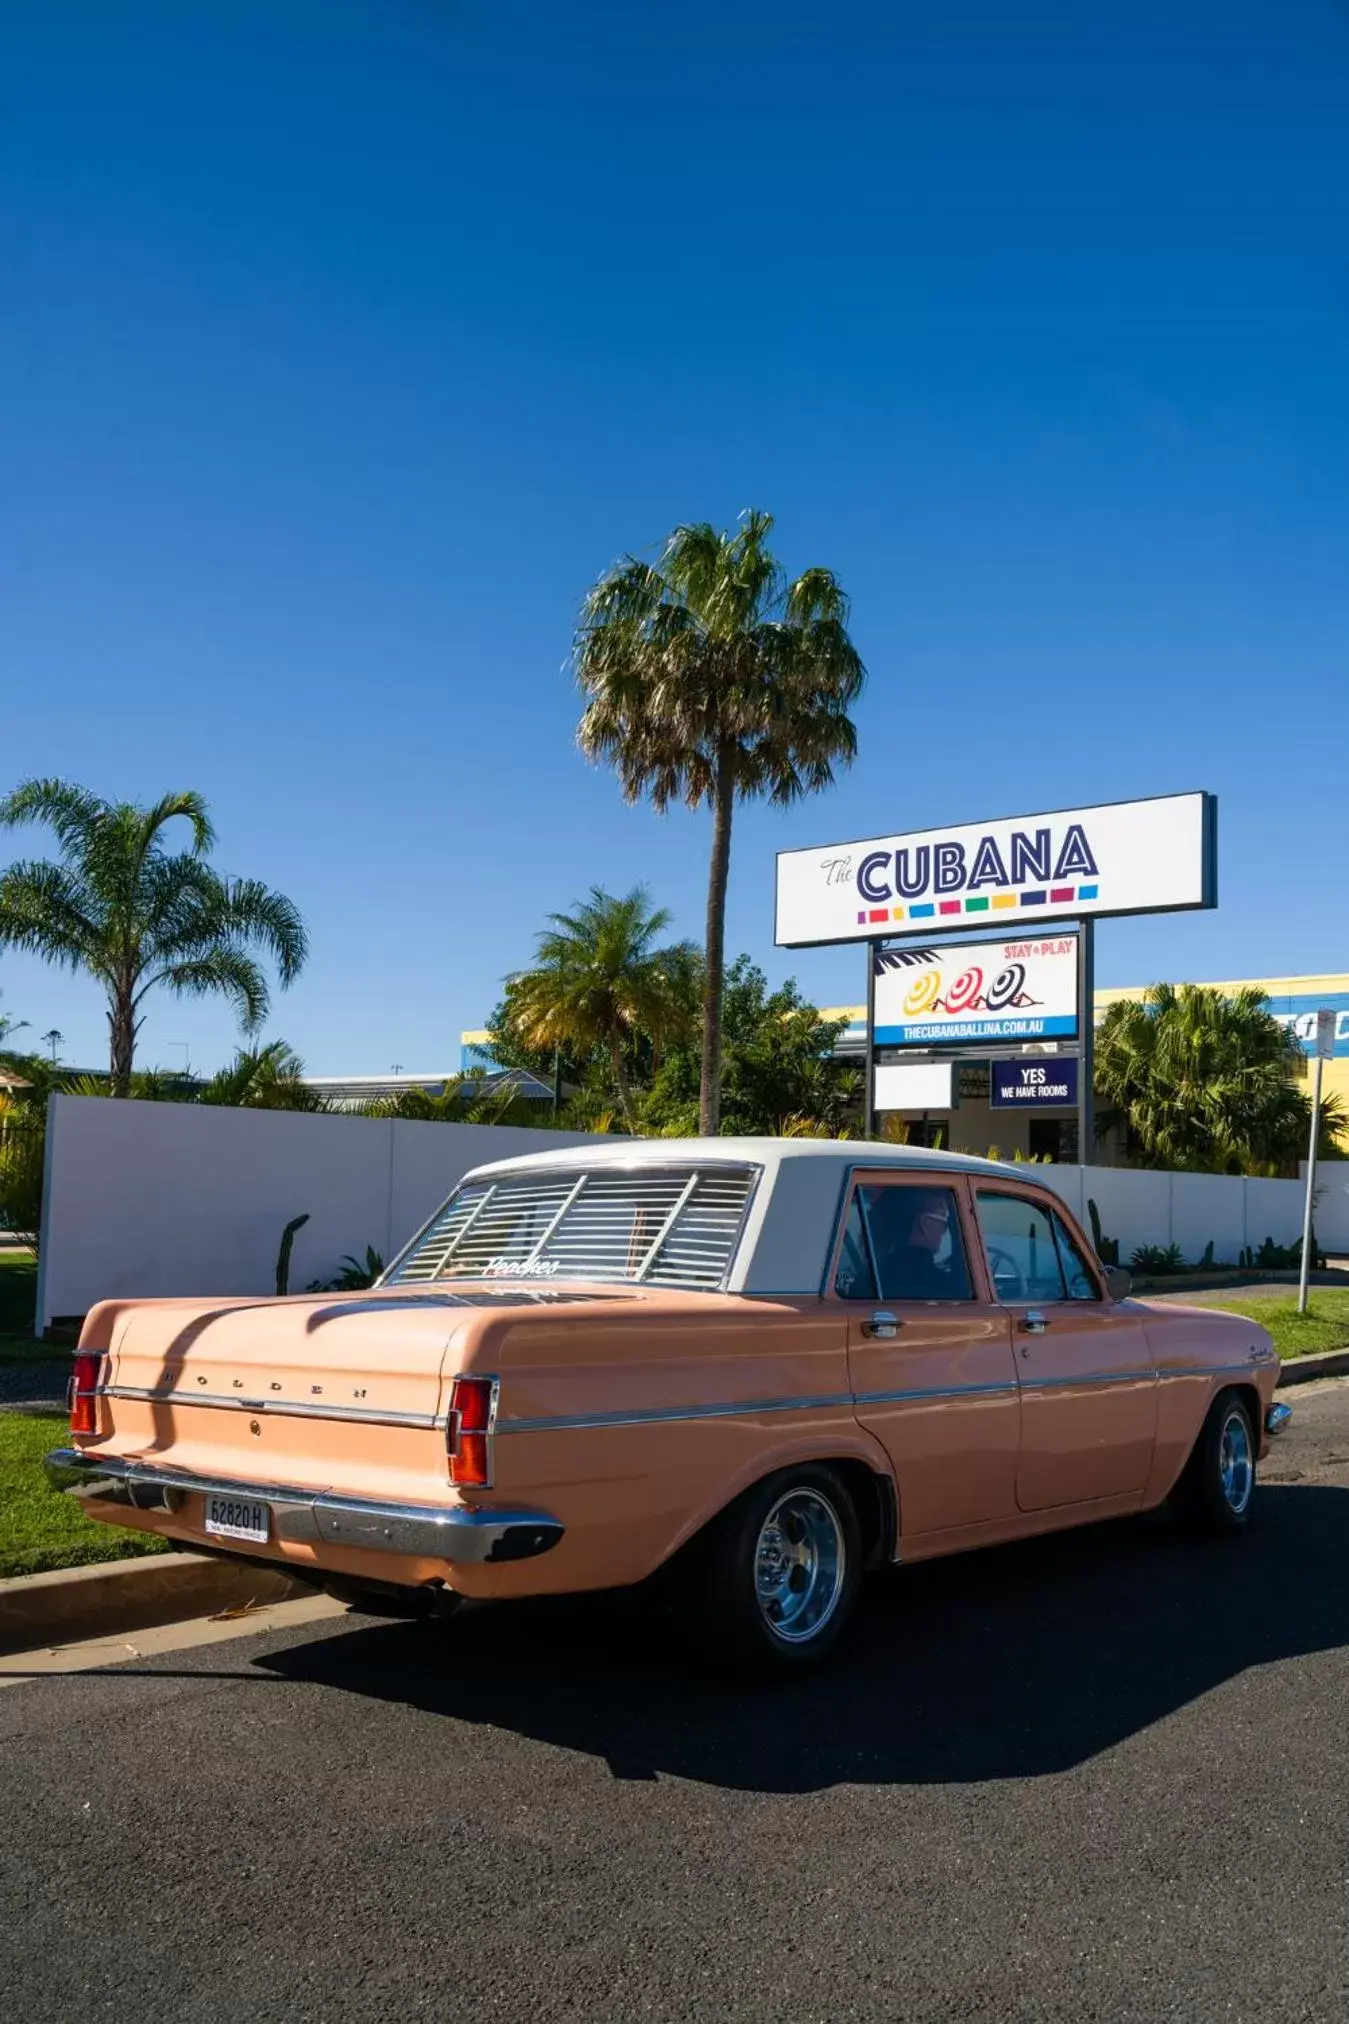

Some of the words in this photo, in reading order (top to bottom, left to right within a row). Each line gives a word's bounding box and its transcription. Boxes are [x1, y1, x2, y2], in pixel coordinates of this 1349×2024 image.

[820, 855, 854, 886] The
[857, 824, 1099, 903] CUBANA
[1004, 943, 1033, 959] STAY
[1041, 940, 1073, 956] PLAY
[904, 1020, 1044, 1040] THECUBANABALLINA.COM.AU
[1021, 1067, 1046, 1084] YES
[1001, 1086, 1015, 1098] WE
[1016, 1085, 1037, 1098] HAVE
[1038, 1084, 1068, 1097] ROOMS
